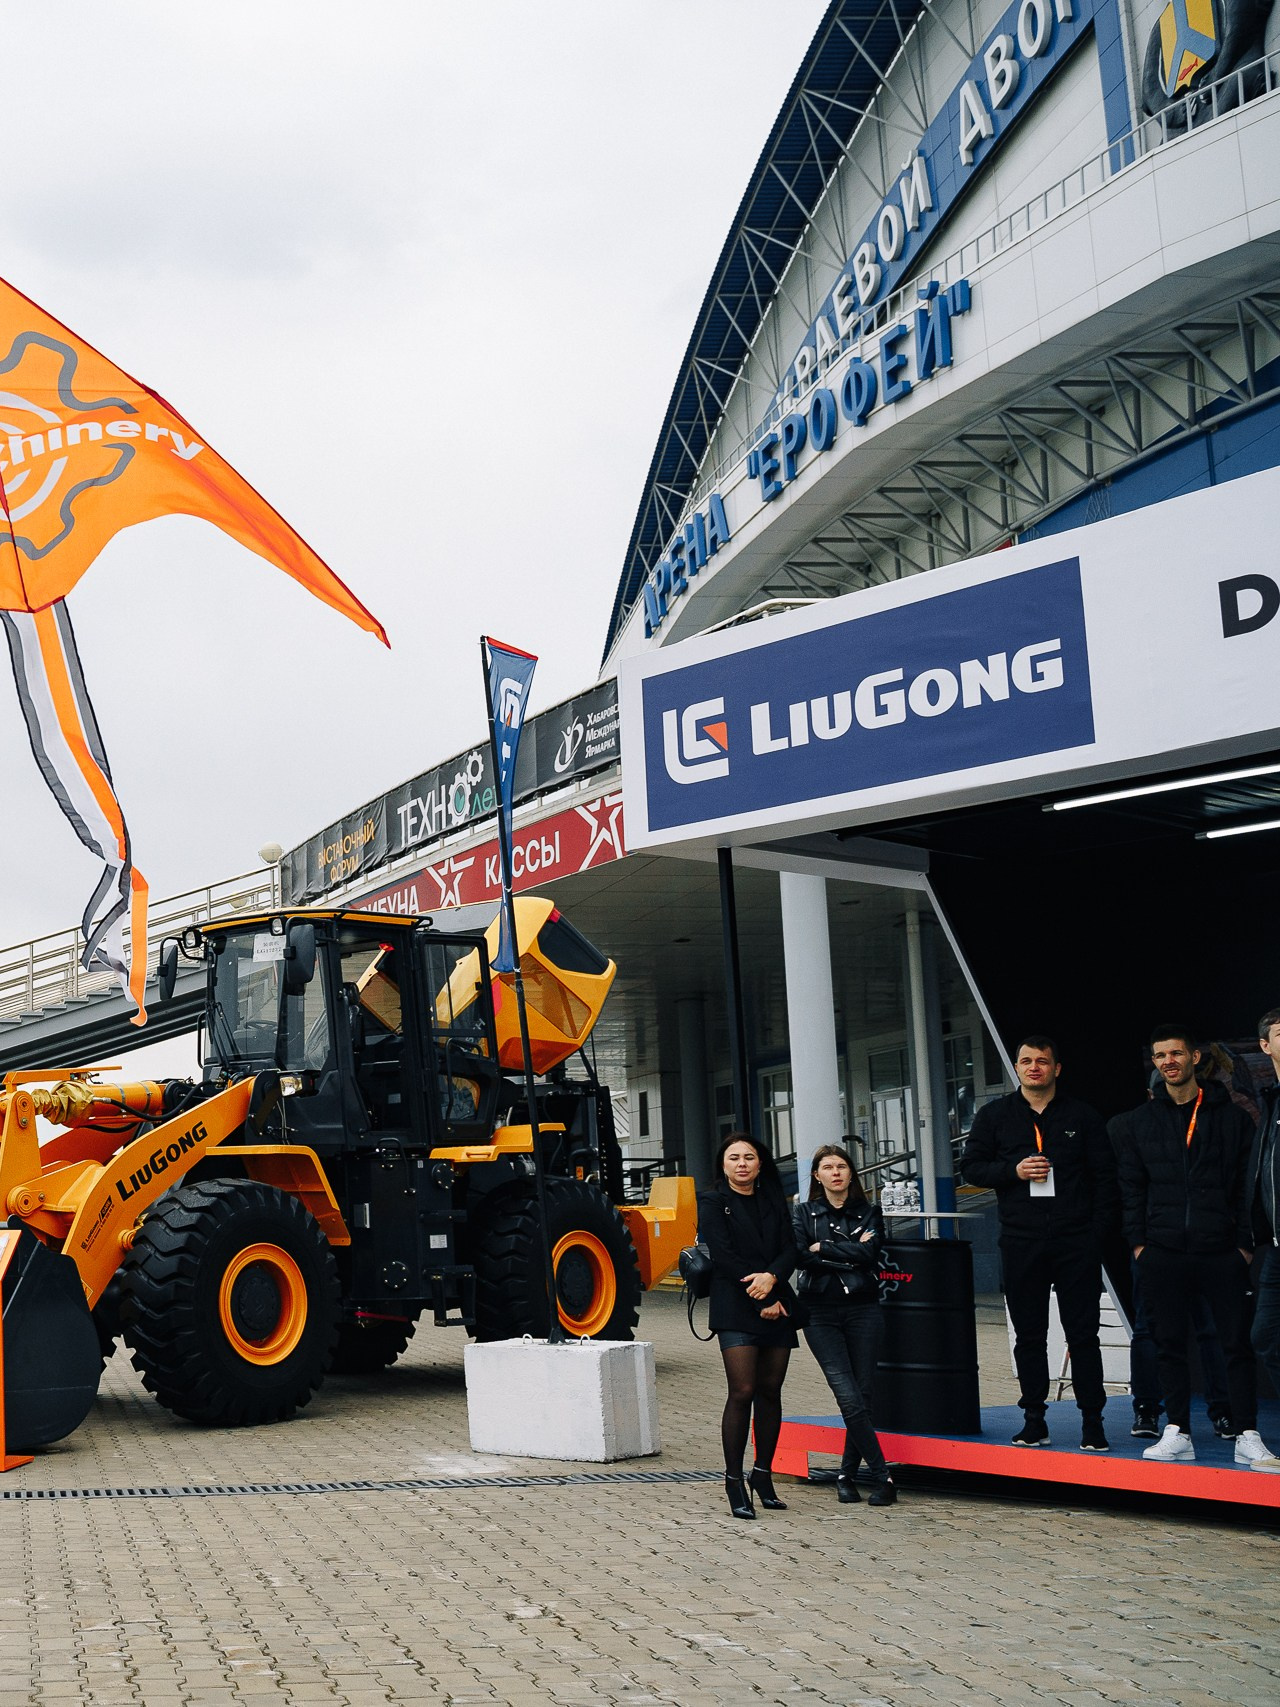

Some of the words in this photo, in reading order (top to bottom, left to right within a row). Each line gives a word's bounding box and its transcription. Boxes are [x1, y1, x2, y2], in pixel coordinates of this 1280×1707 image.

[959, 0, 1073, 166] ДВО
[642, 493, 730, 639] АРЕНА
[747, 279, 972, 501] "ЕРОФЕЙ"
[330, 853, 360, 881] ФОРУМ
[485, 831, 561, 888] КССЫ
